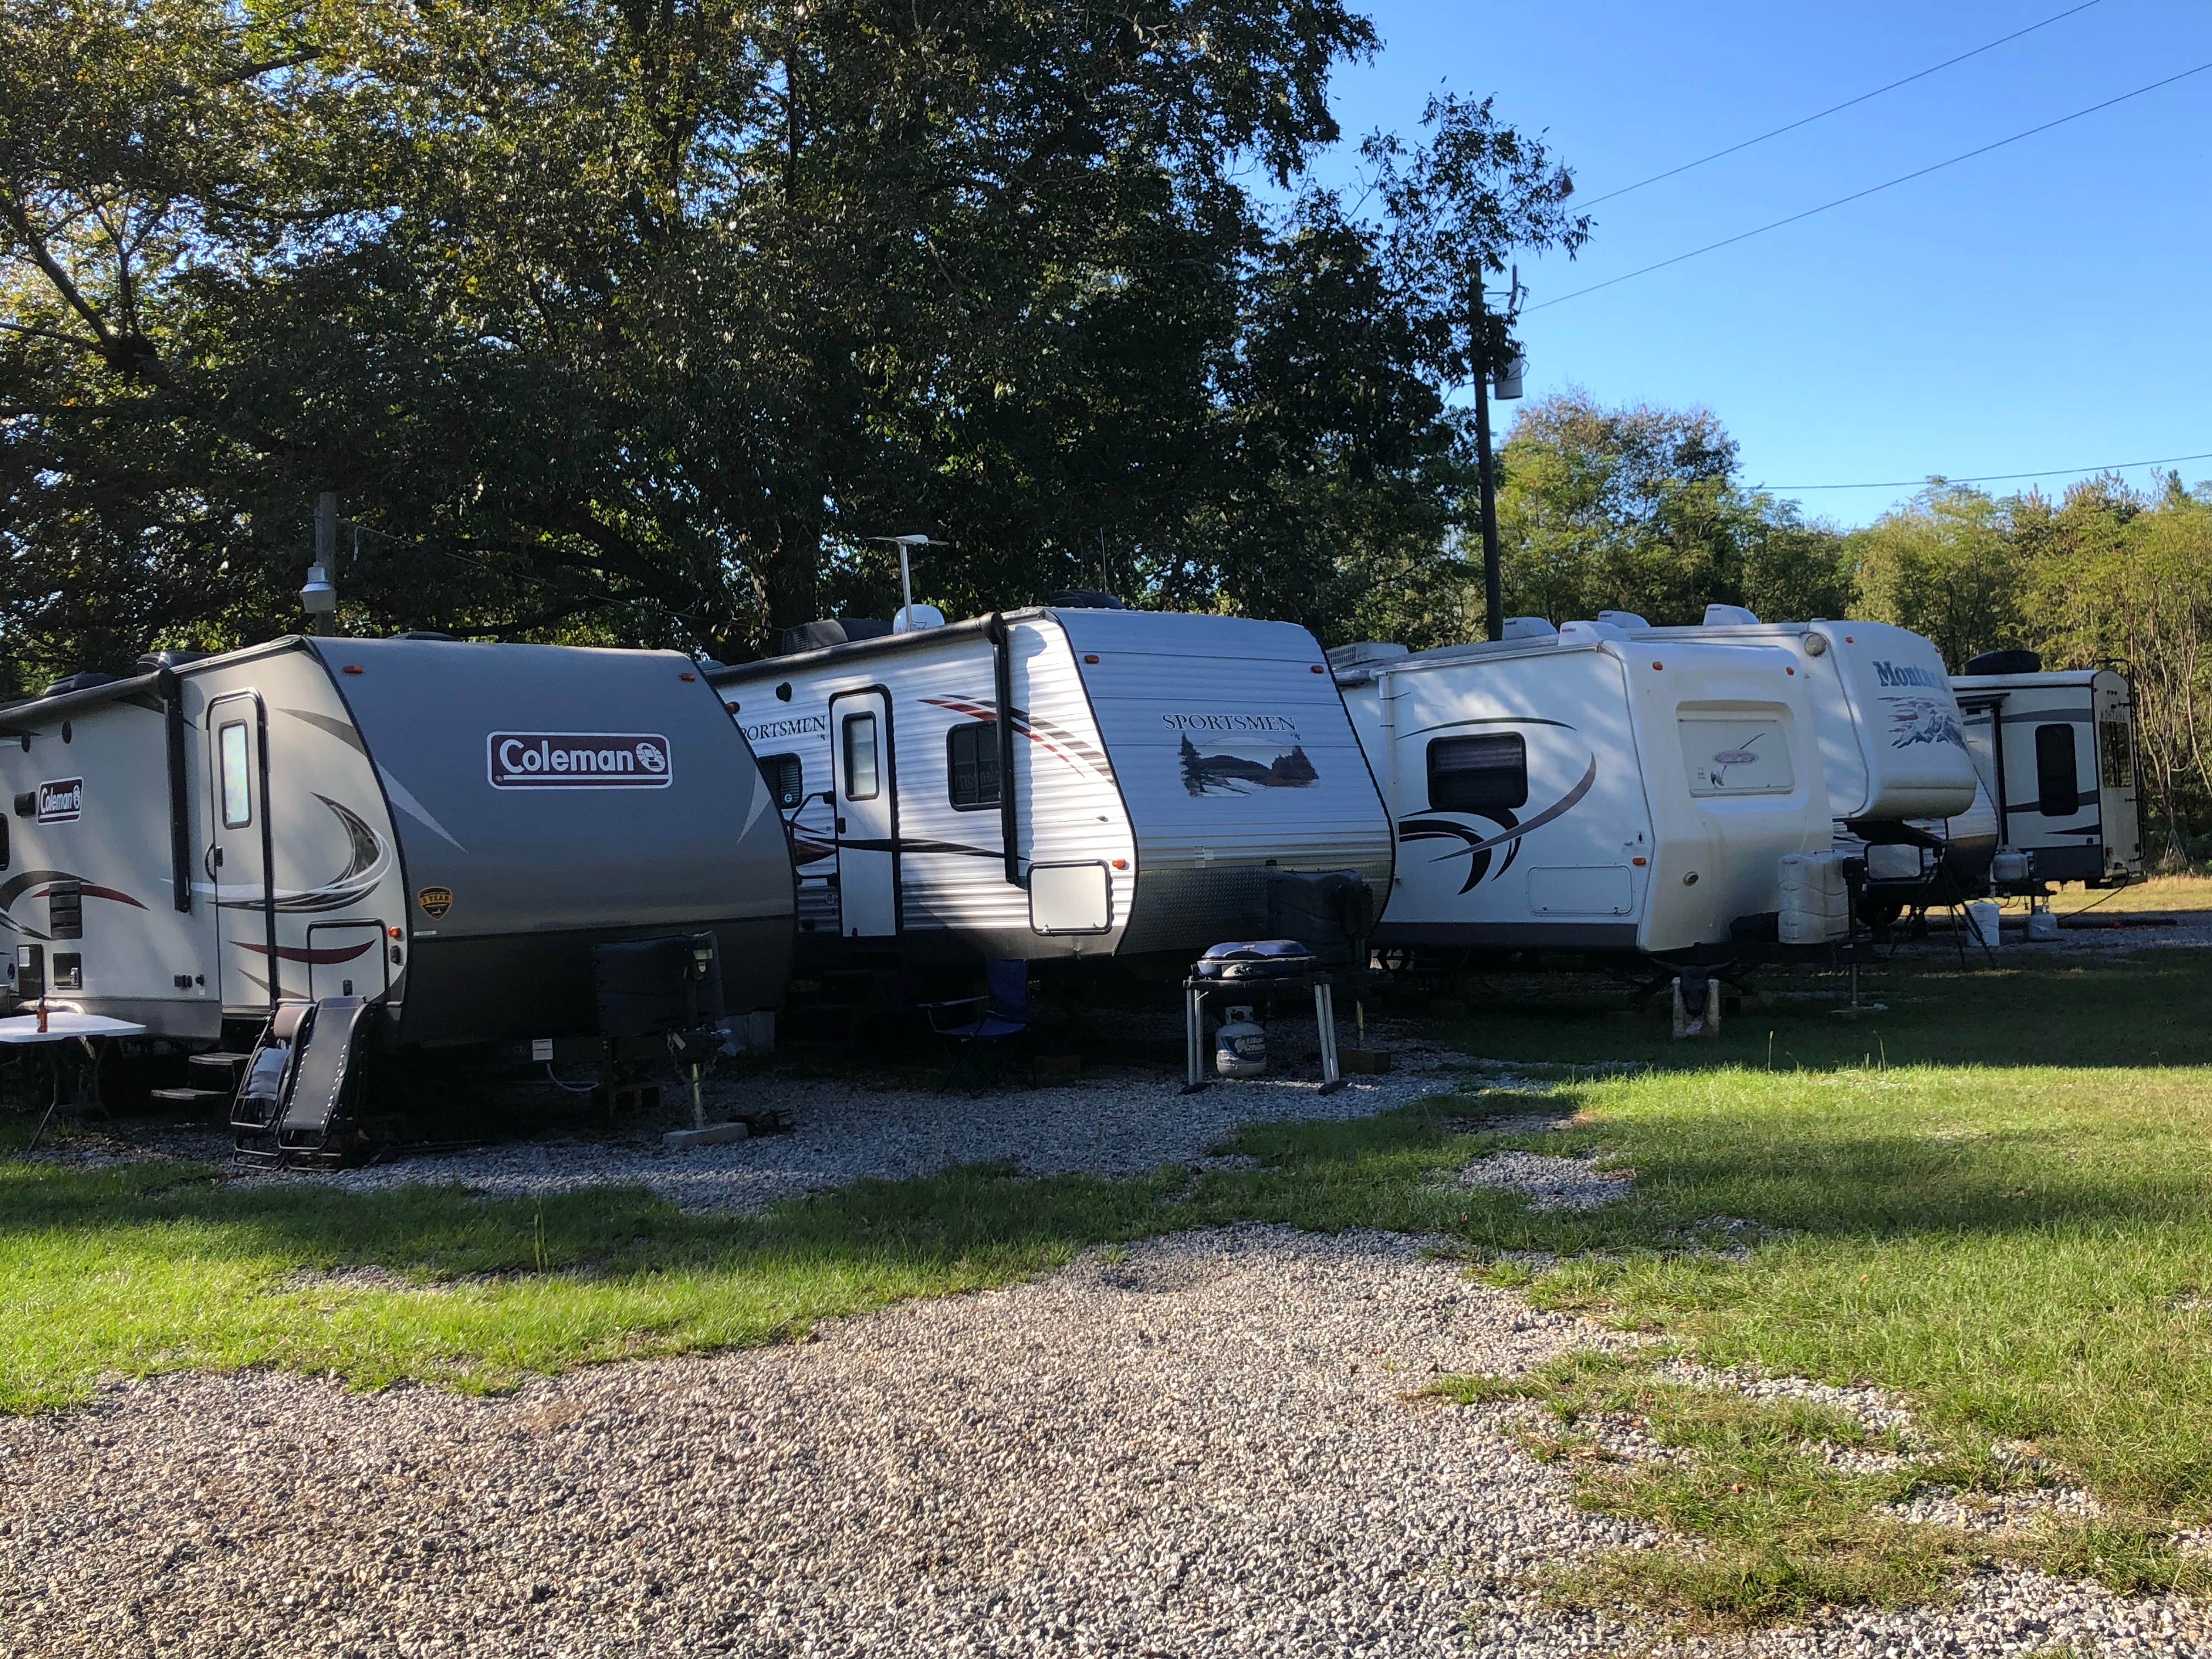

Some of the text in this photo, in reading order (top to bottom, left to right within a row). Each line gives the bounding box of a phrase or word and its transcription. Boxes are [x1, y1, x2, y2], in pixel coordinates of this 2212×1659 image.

[741, 715, 825, 741] PORTSMEN
[1163, 714, 1296, 730] SPORTSMEN
[500, 739, 634, 773] Coleman
[41, 787, 72, 813] Coleman
